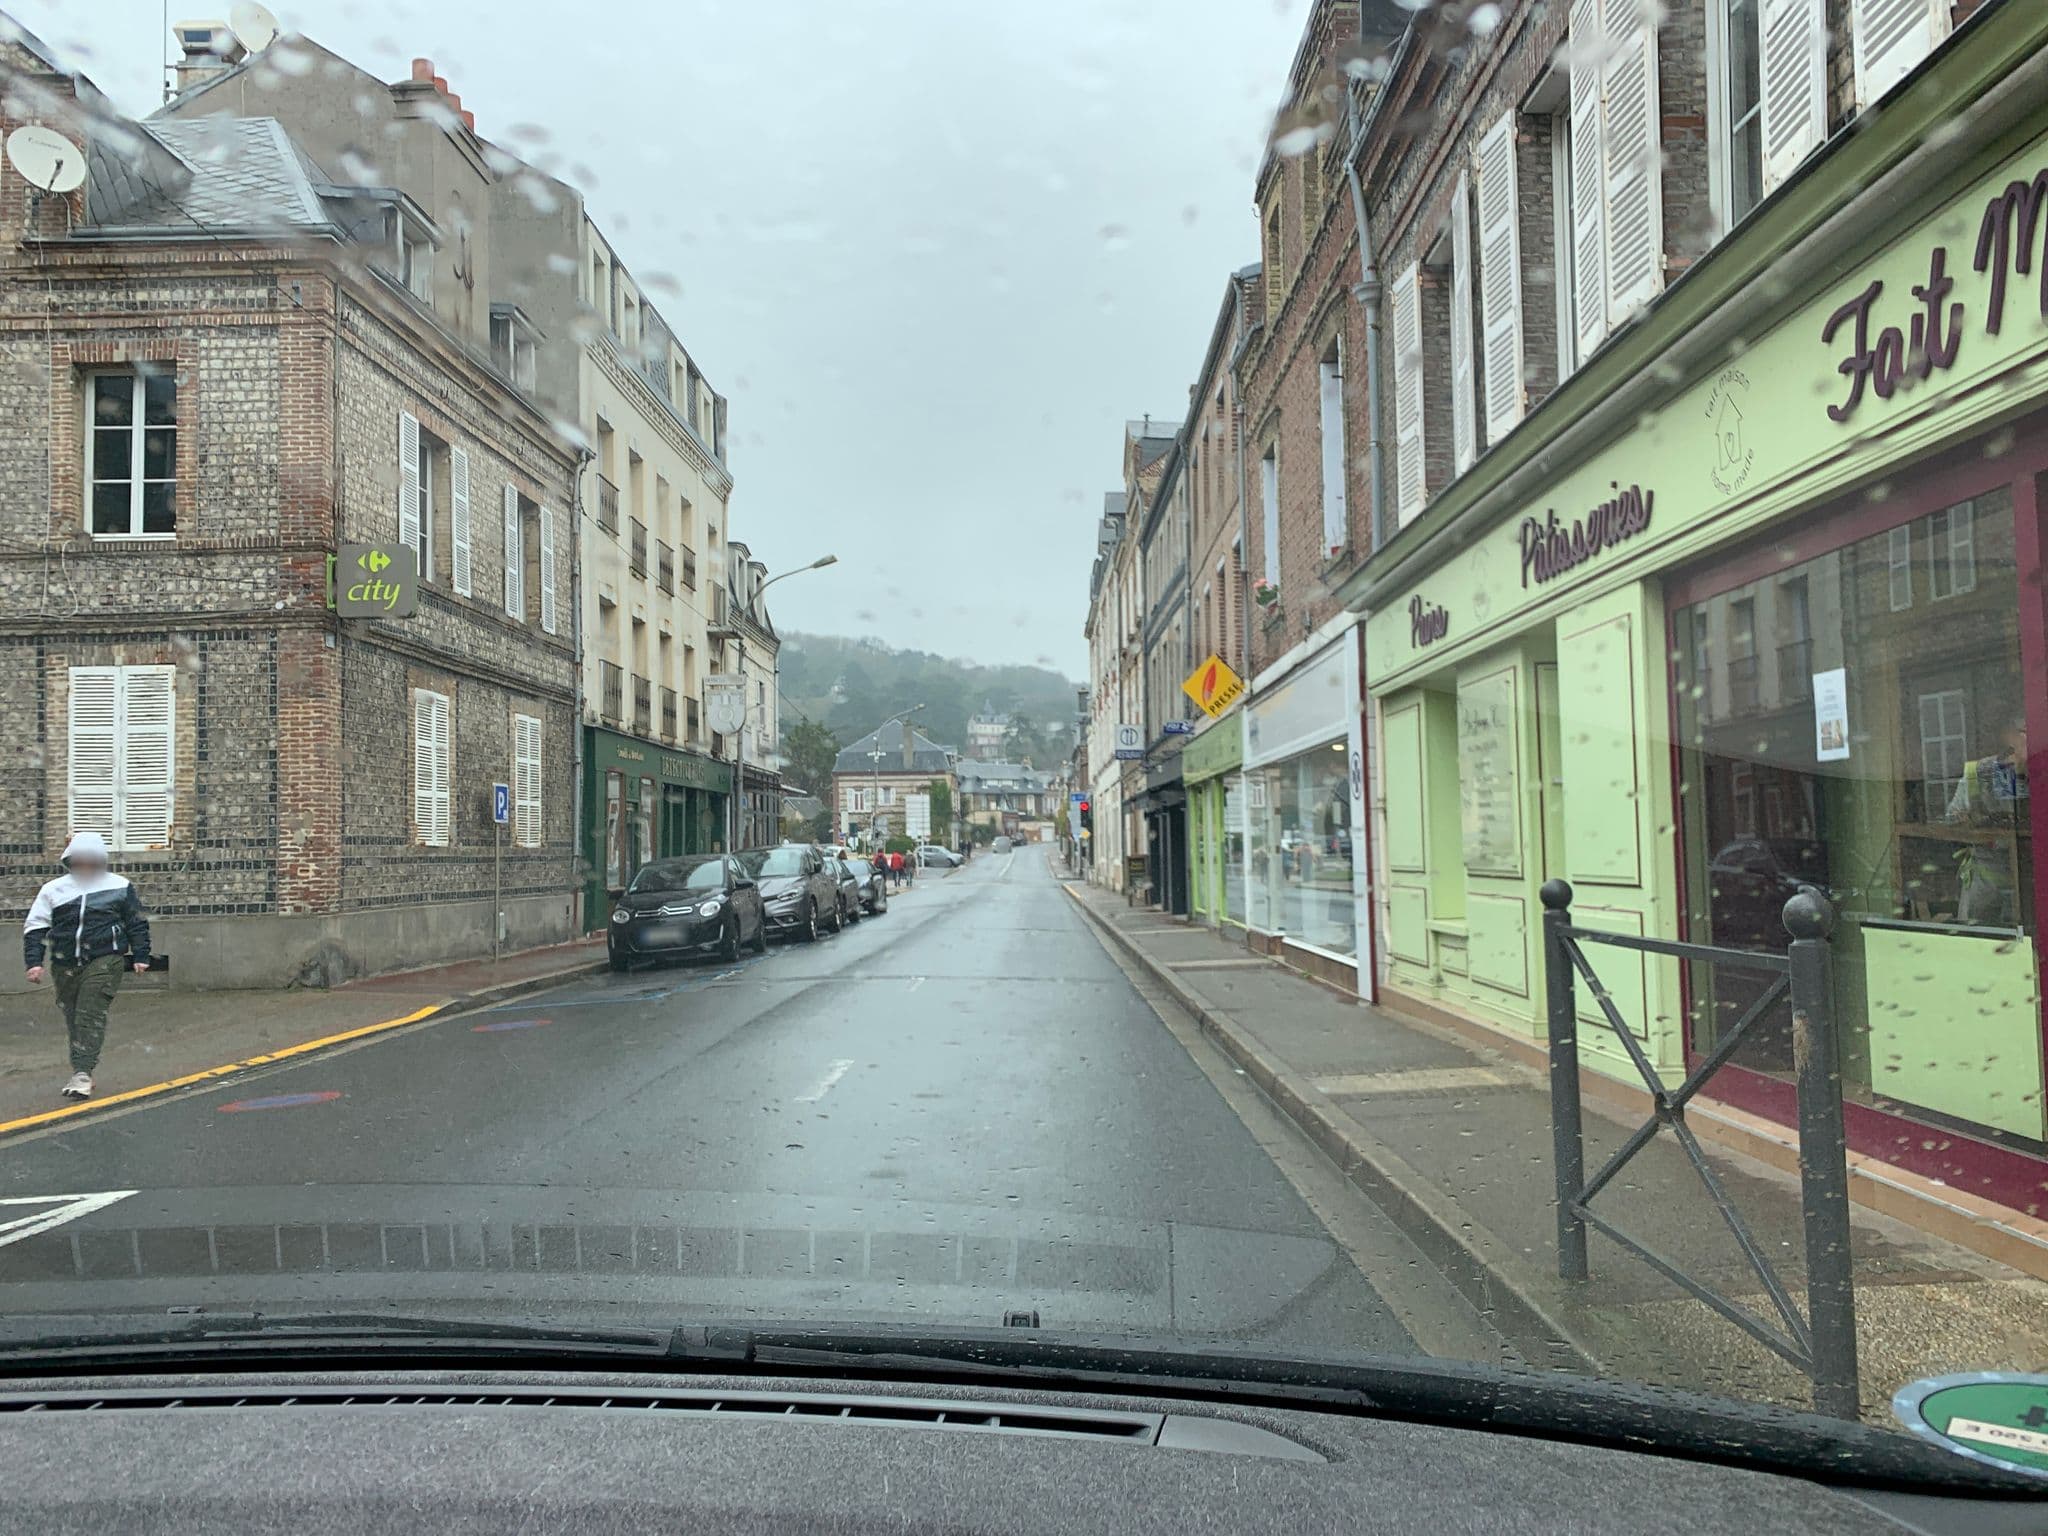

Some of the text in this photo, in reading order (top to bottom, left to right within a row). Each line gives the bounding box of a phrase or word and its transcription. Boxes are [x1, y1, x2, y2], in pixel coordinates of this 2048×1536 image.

[1822, 247, 1965, 422] Fait
[1519, 481, 1654, 589] Pâtisseries
[347, 579, 401, 610] city
[1409, 594, 1449, 649] Pains
[1208, 682, 1240, 714] PRESSE
[498, 791, 505, 815] P
